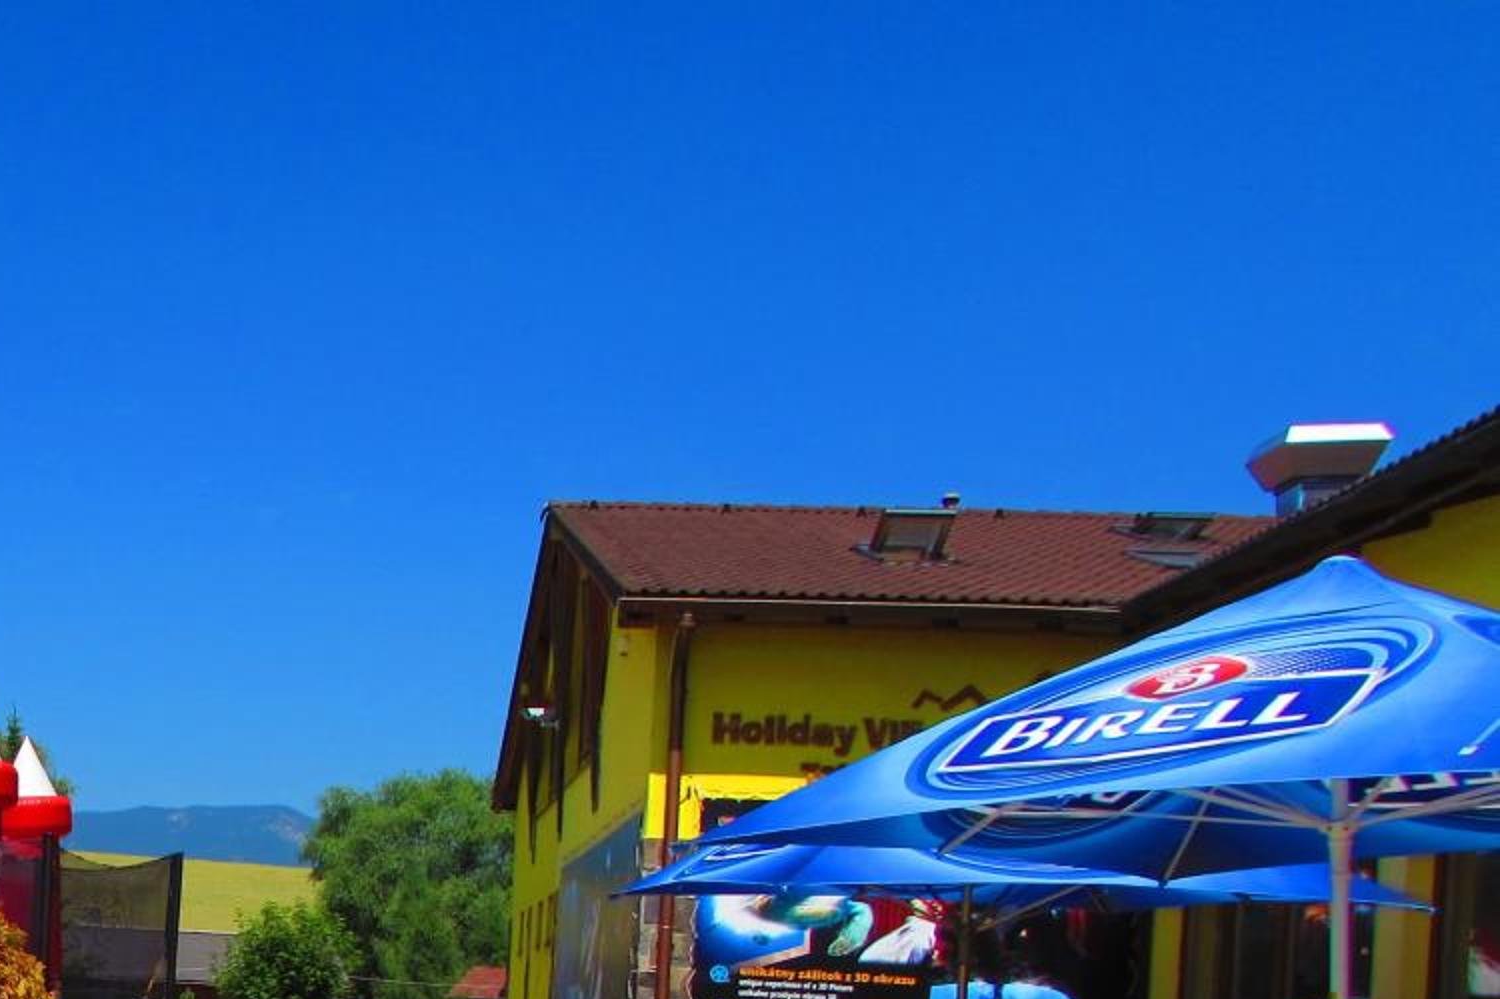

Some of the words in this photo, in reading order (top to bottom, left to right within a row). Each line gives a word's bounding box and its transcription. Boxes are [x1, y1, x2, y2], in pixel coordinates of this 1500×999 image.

[712, 711, 857, 758] Holiday
[977, 690, 1311, 760] BIRELL
[872, 973, 917, 986] obrazu
